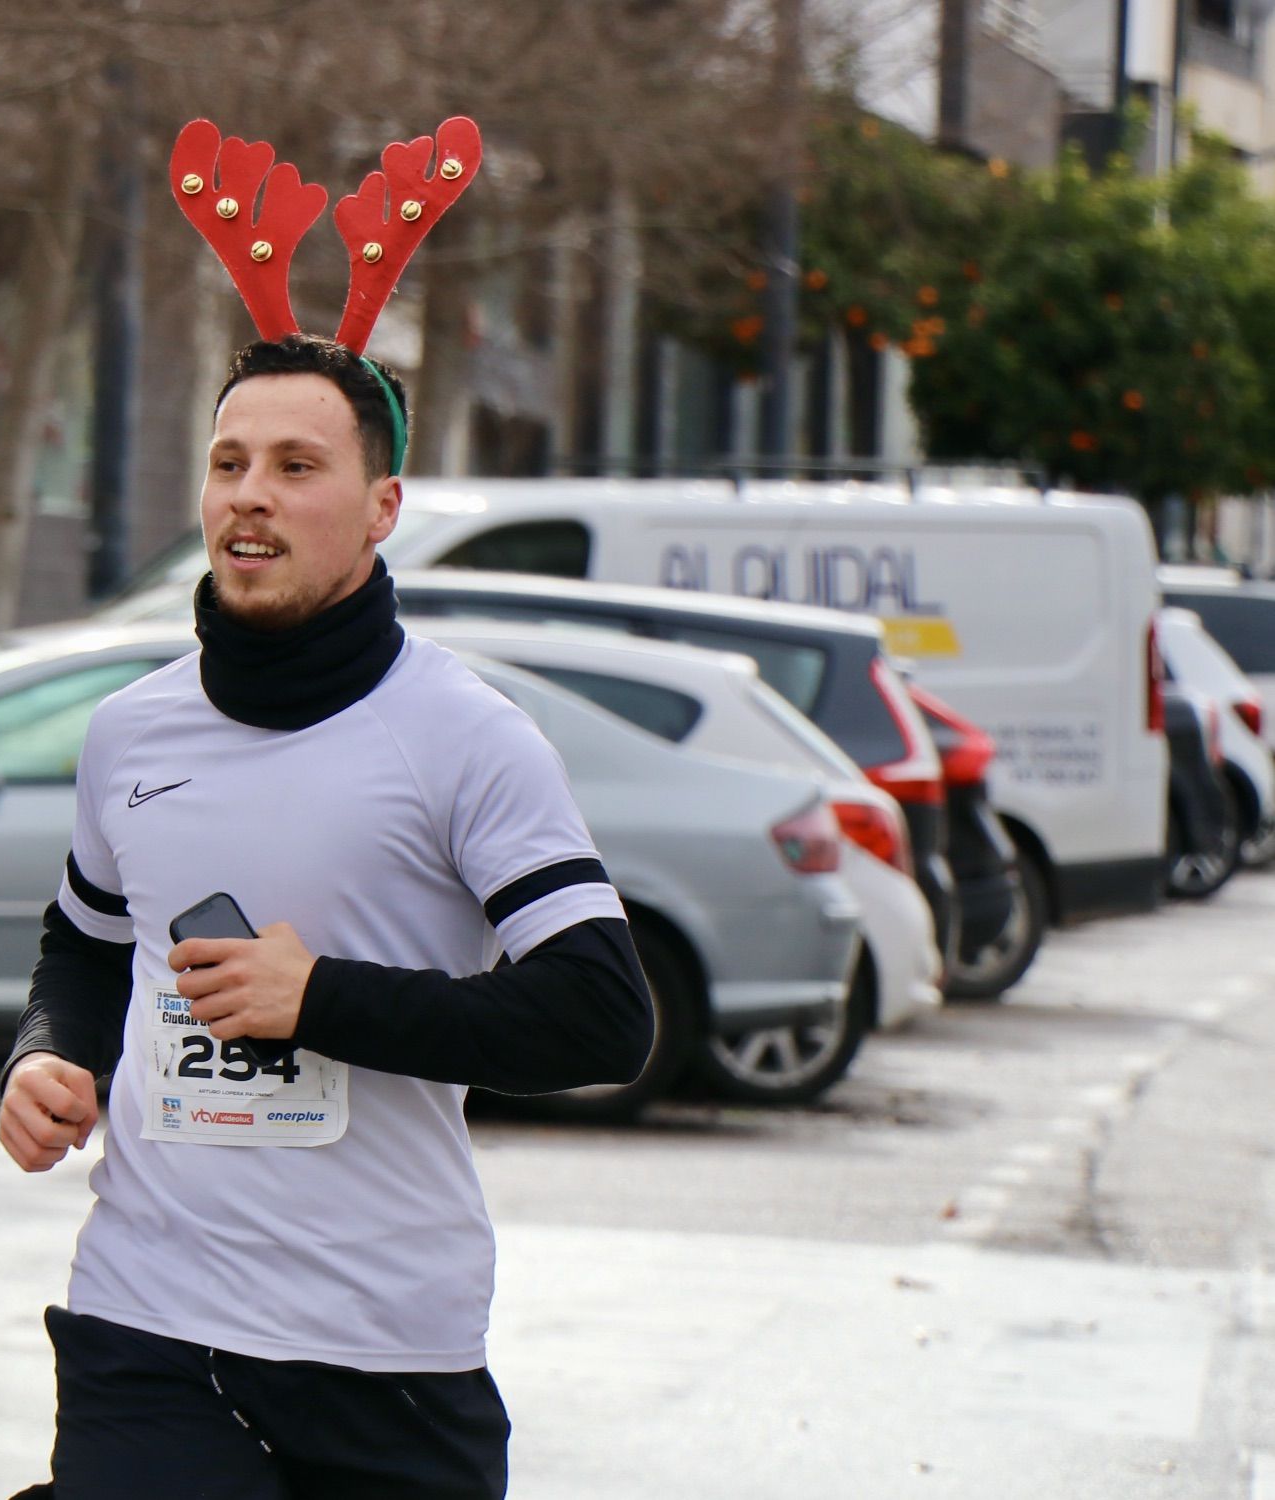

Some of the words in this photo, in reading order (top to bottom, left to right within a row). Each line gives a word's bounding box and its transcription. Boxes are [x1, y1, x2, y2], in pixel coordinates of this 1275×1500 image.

[163, 998, 182, 1011] San
[178, 1035, 301, 1084] 254
[267, 1111, 324, 1123] enerplus
